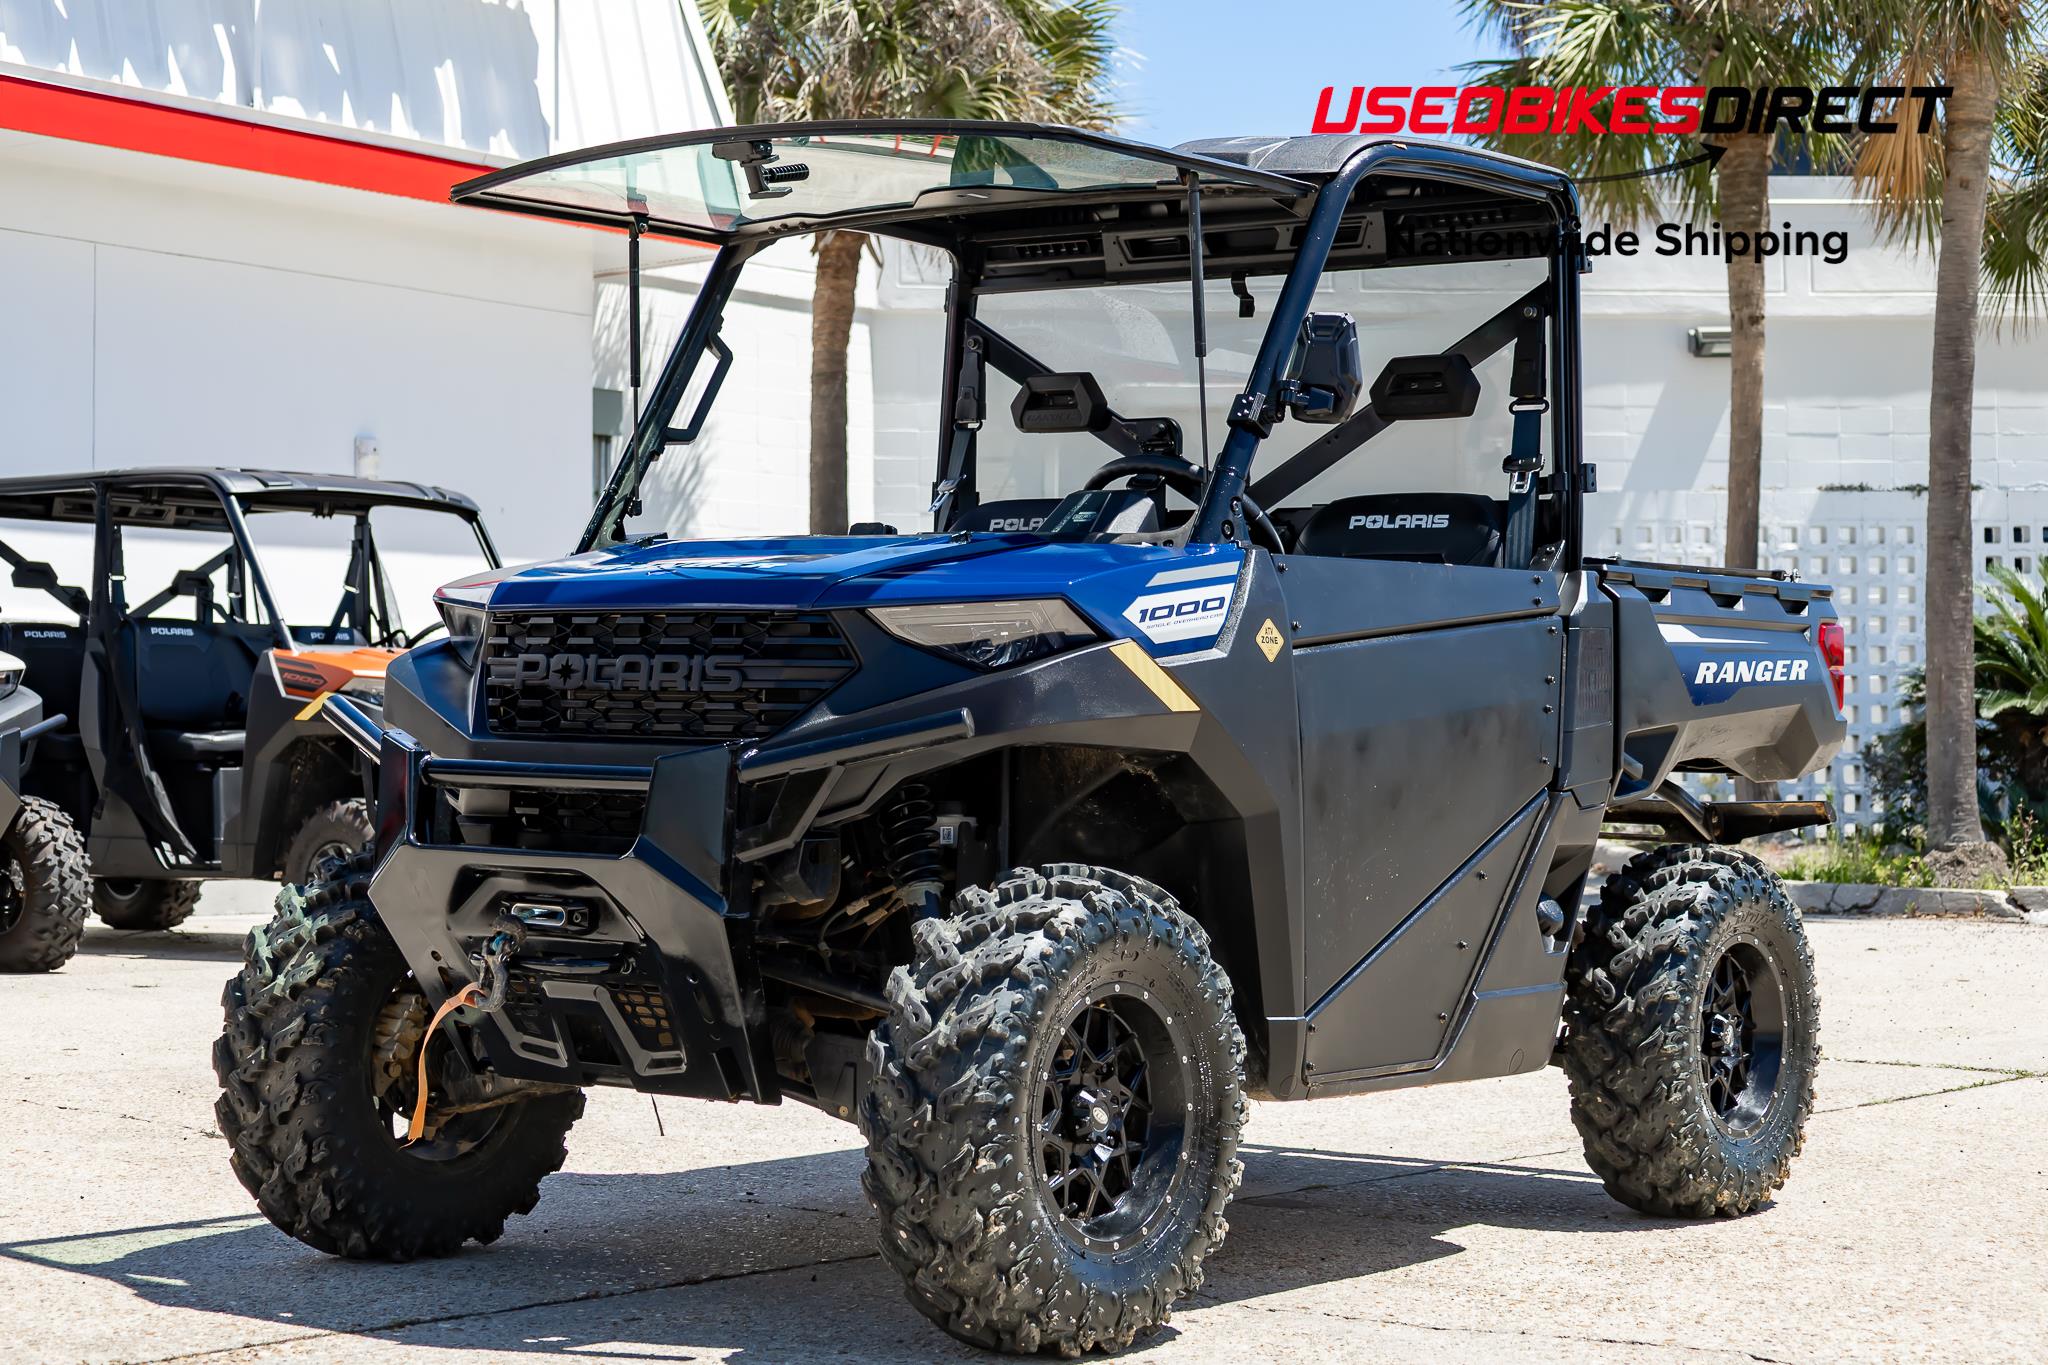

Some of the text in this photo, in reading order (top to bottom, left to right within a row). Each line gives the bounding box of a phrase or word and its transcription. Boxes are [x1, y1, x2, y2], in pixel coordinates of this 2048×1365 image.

[989, 517, 1047, 532] POLA
[1349, 514, 1450, 529] POLARIS
[1138, 596, 1226, 623] 1000
[24, 630, 67, 639] POLARIS
[150, 627, 194, 637] POLARIS
[1264, 627, 1274, 635] ATV
[1261, 635, 1279, 645] ZONE
[282, 671, 322, 685] 1000
[514, 653, 746, 692] POLARIS
[1694, 659, 1809, 685] RANGER
